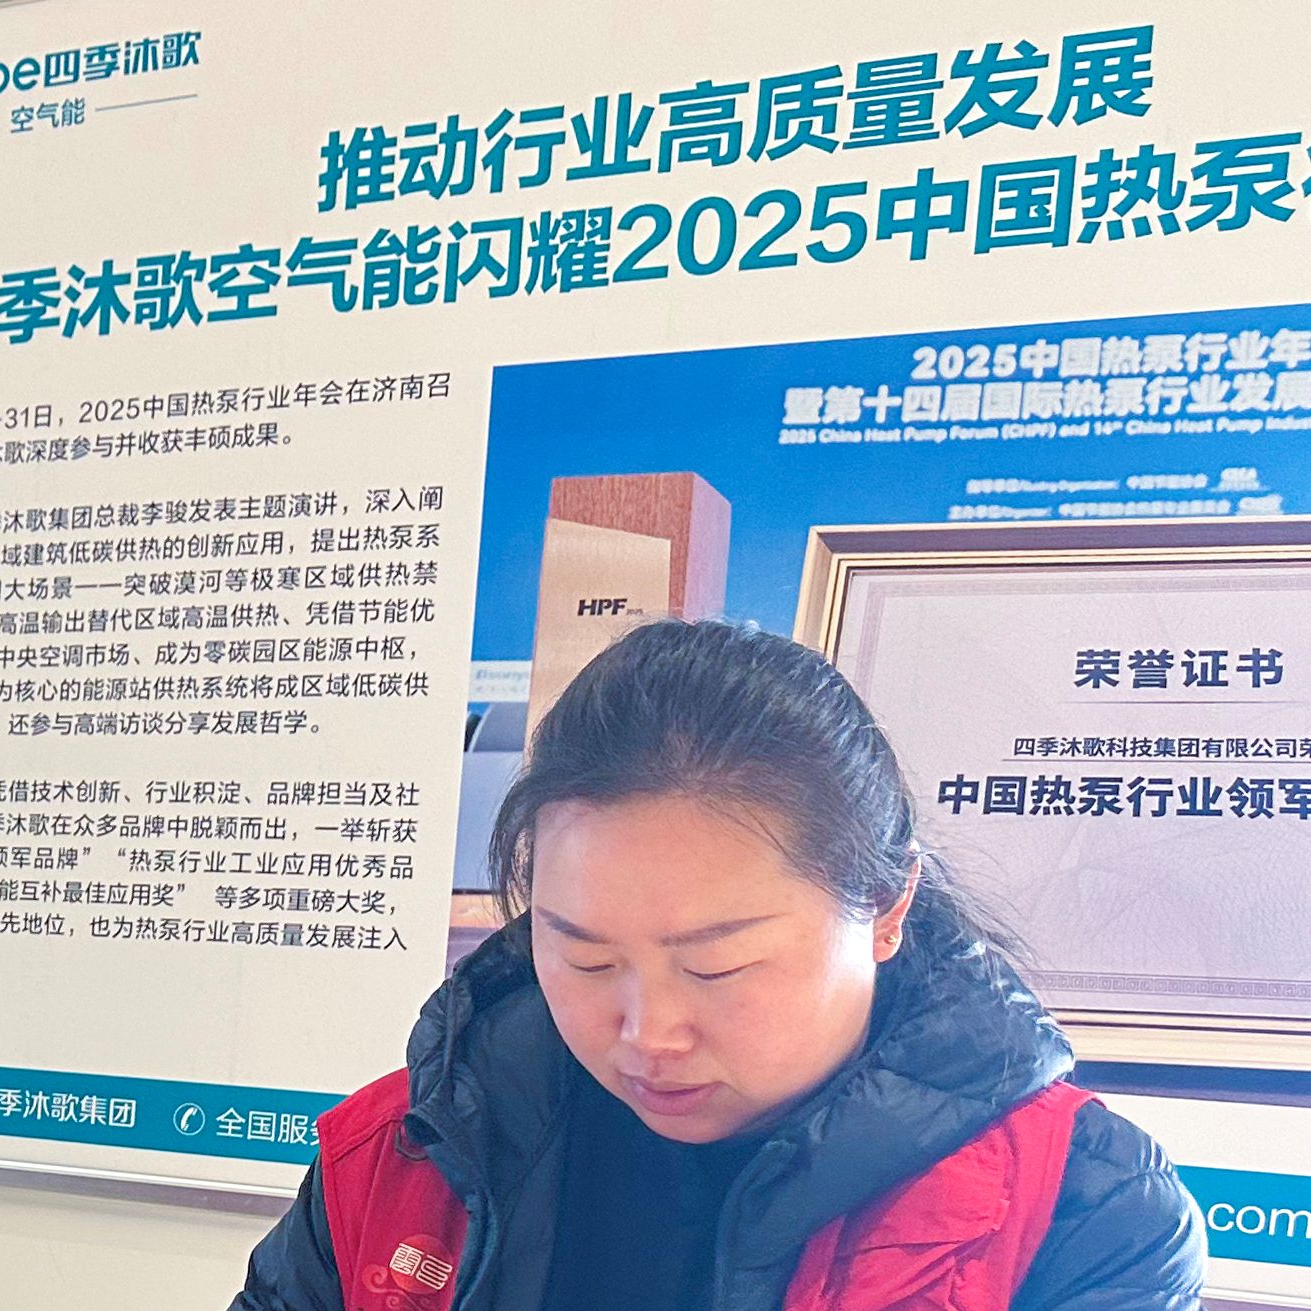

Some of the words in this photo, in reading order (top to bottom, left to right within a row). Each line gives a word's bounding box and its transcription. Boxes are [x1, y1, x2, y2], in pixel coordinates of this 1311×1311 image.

[9, 98, 86, 134] 空气能
[316, 24, 1155, 214] 推动行业高质量发展
[577, 598, 628, 616] HPF
[1074, 647, 1284, 690] 荣誉证书
